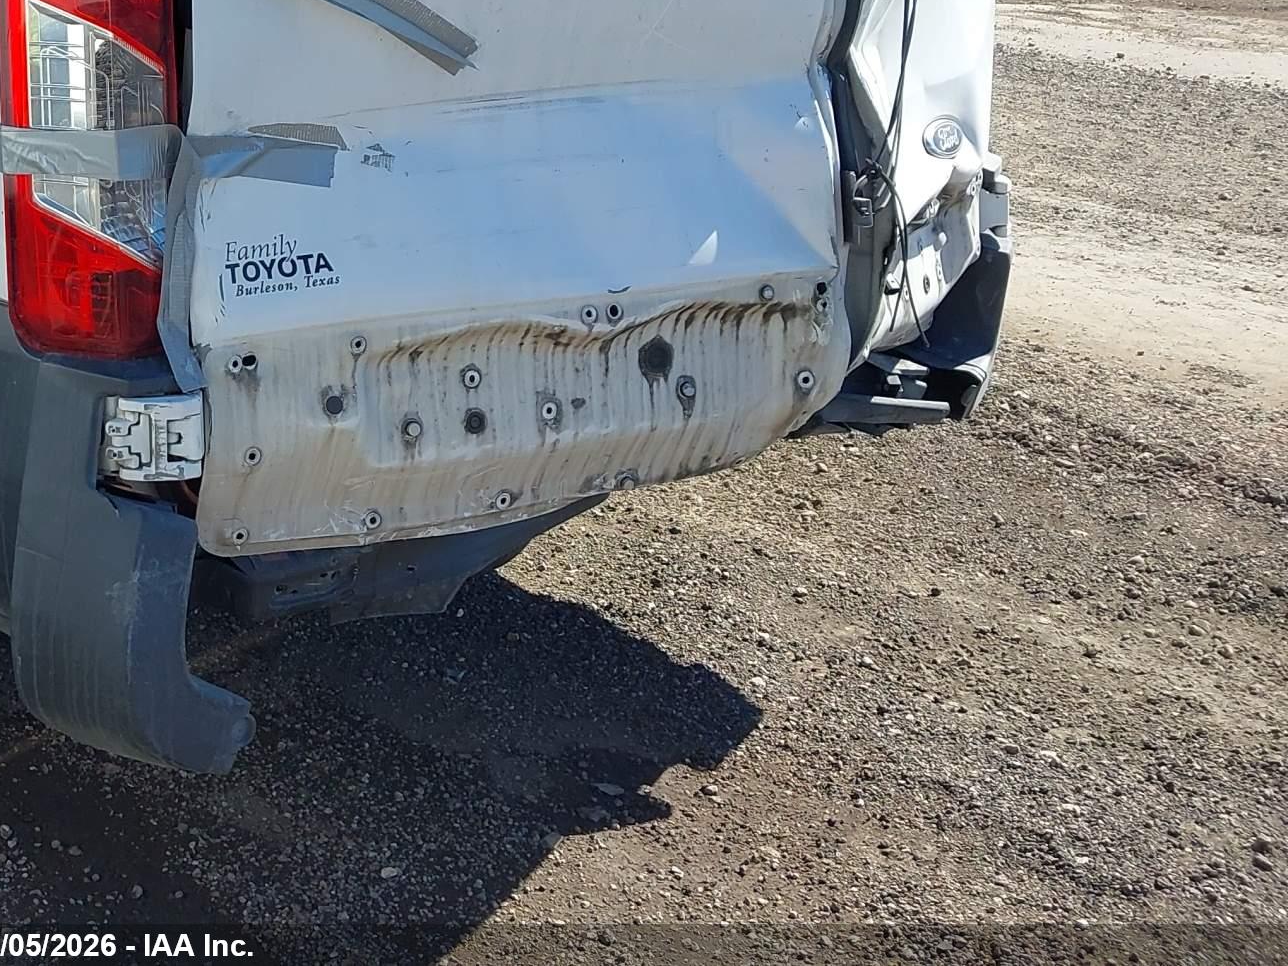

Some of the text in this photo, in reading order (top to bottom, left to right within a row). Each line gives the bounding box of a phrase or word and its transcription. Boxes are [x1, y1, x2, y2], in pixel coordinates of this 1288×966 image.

[225, 234, 297, 262] Family
[225, 253, 334, 284] TOYOTA
[236, 274, 340, 297] Burleson, Texas
